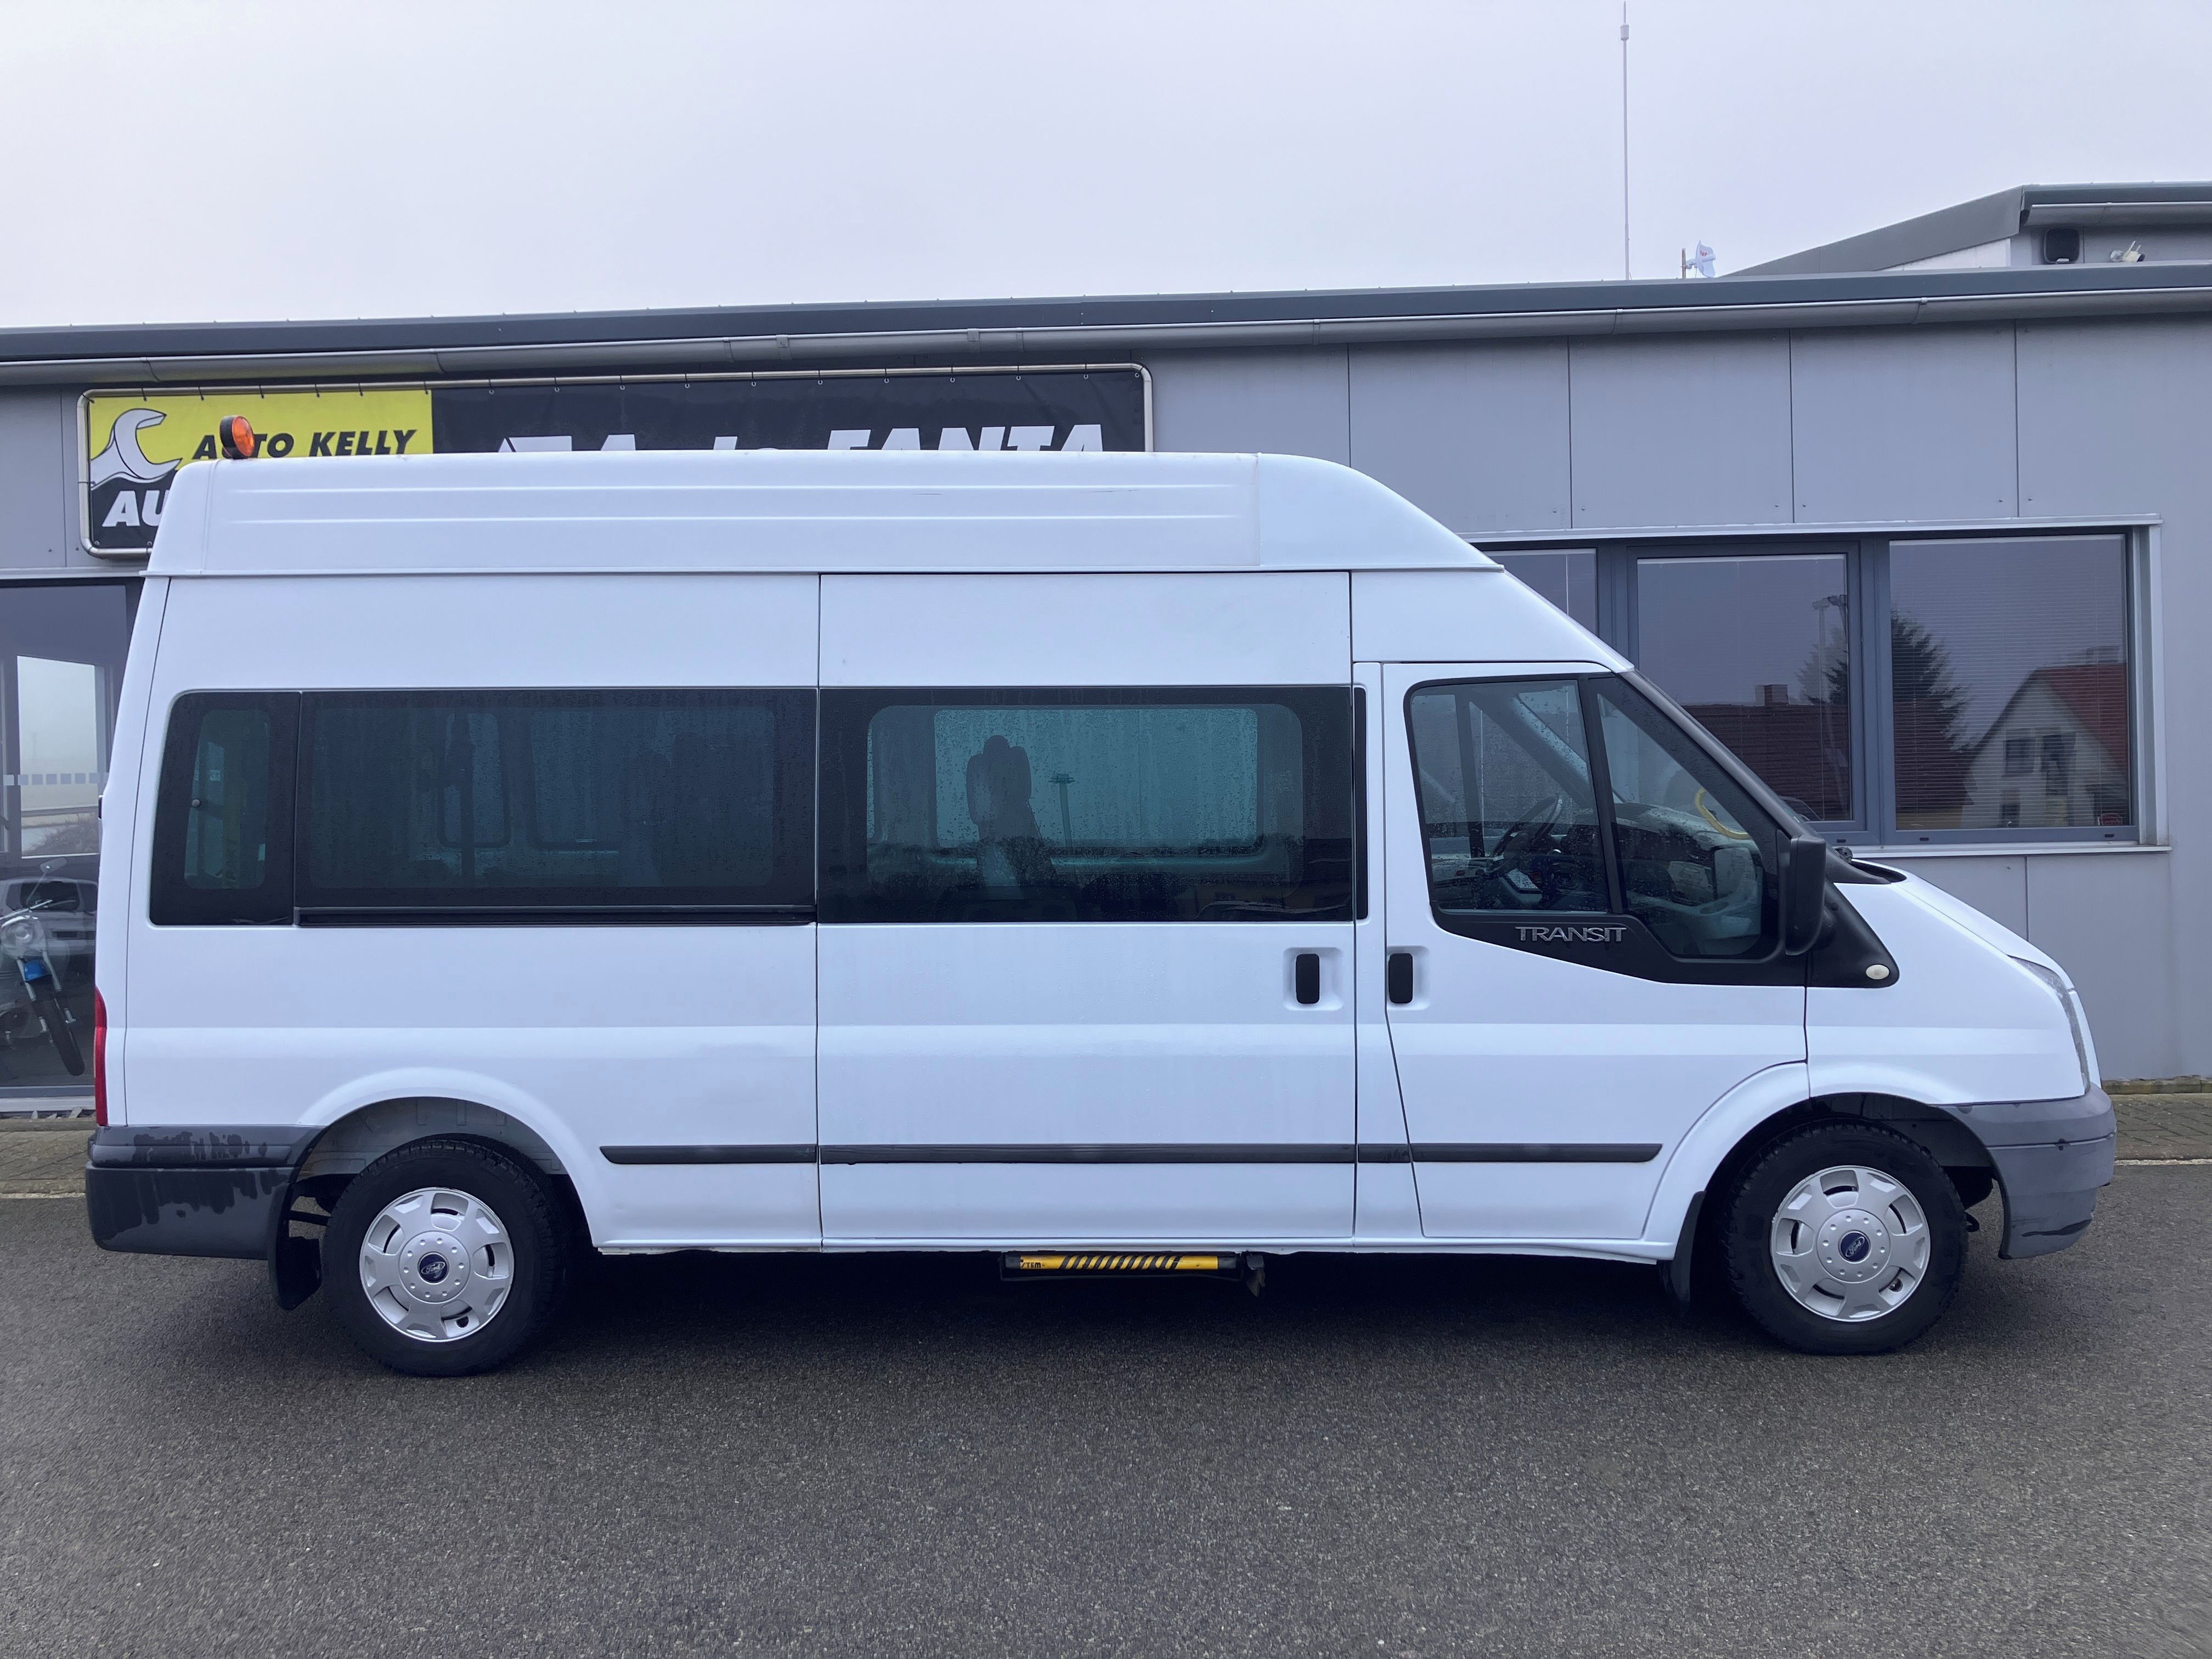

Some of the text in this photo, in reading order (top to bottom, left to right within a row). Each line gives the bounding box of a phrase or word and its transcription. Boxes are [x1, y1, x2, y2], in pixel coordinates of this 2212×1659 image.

[192, 429, 417, 459] ATO KELLY
[1515, 926, 1627, 942] TRANSIT
